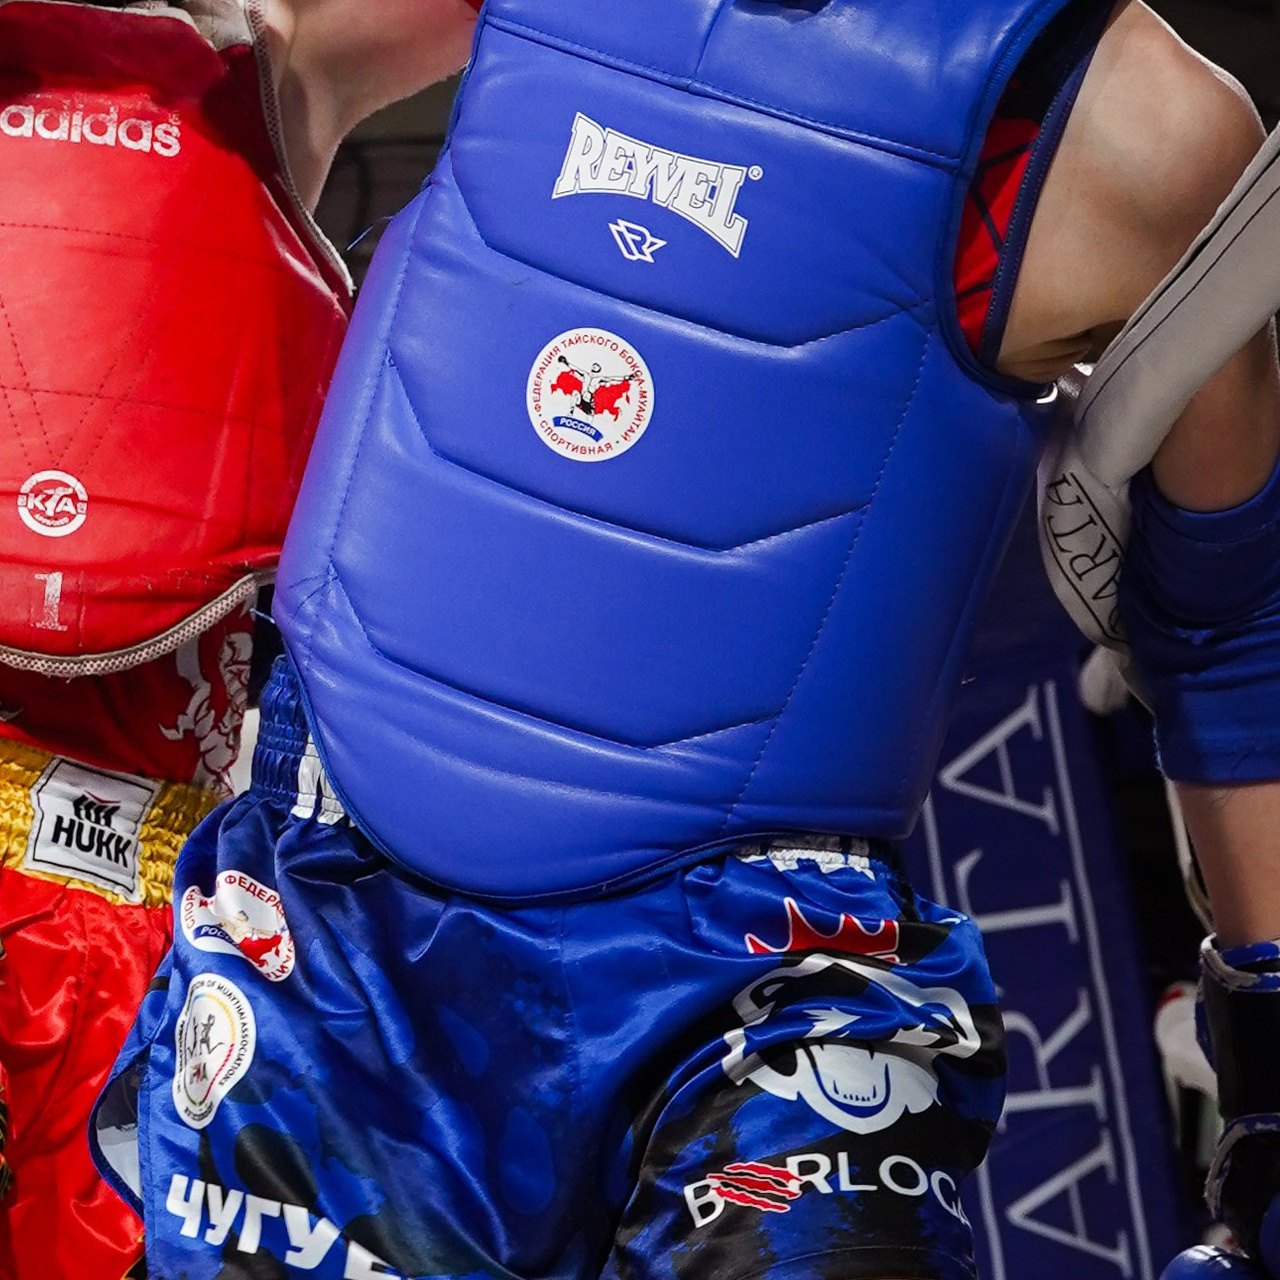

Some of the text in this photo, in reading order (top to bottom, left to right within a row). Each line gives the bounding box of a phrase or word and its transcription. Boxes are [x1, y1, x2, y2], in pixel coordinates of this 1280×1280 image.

[551, 111, 749, 259] REYVEL
[533, 345, 562, 413] ФЕДЕРАЦИЯ
[561, 333, 619, 351] ТАЙСКОГО
[540, 419, 614, 455] СПОРТИВНАЯ
[559, 417, 597, 436] РОССИЯ
[51, 814, 132, 869] HUKK
[216, 984, 248, 1022] MUAYTHAI
[218, 1021, 249, 1087] ASSOCIATIONS
